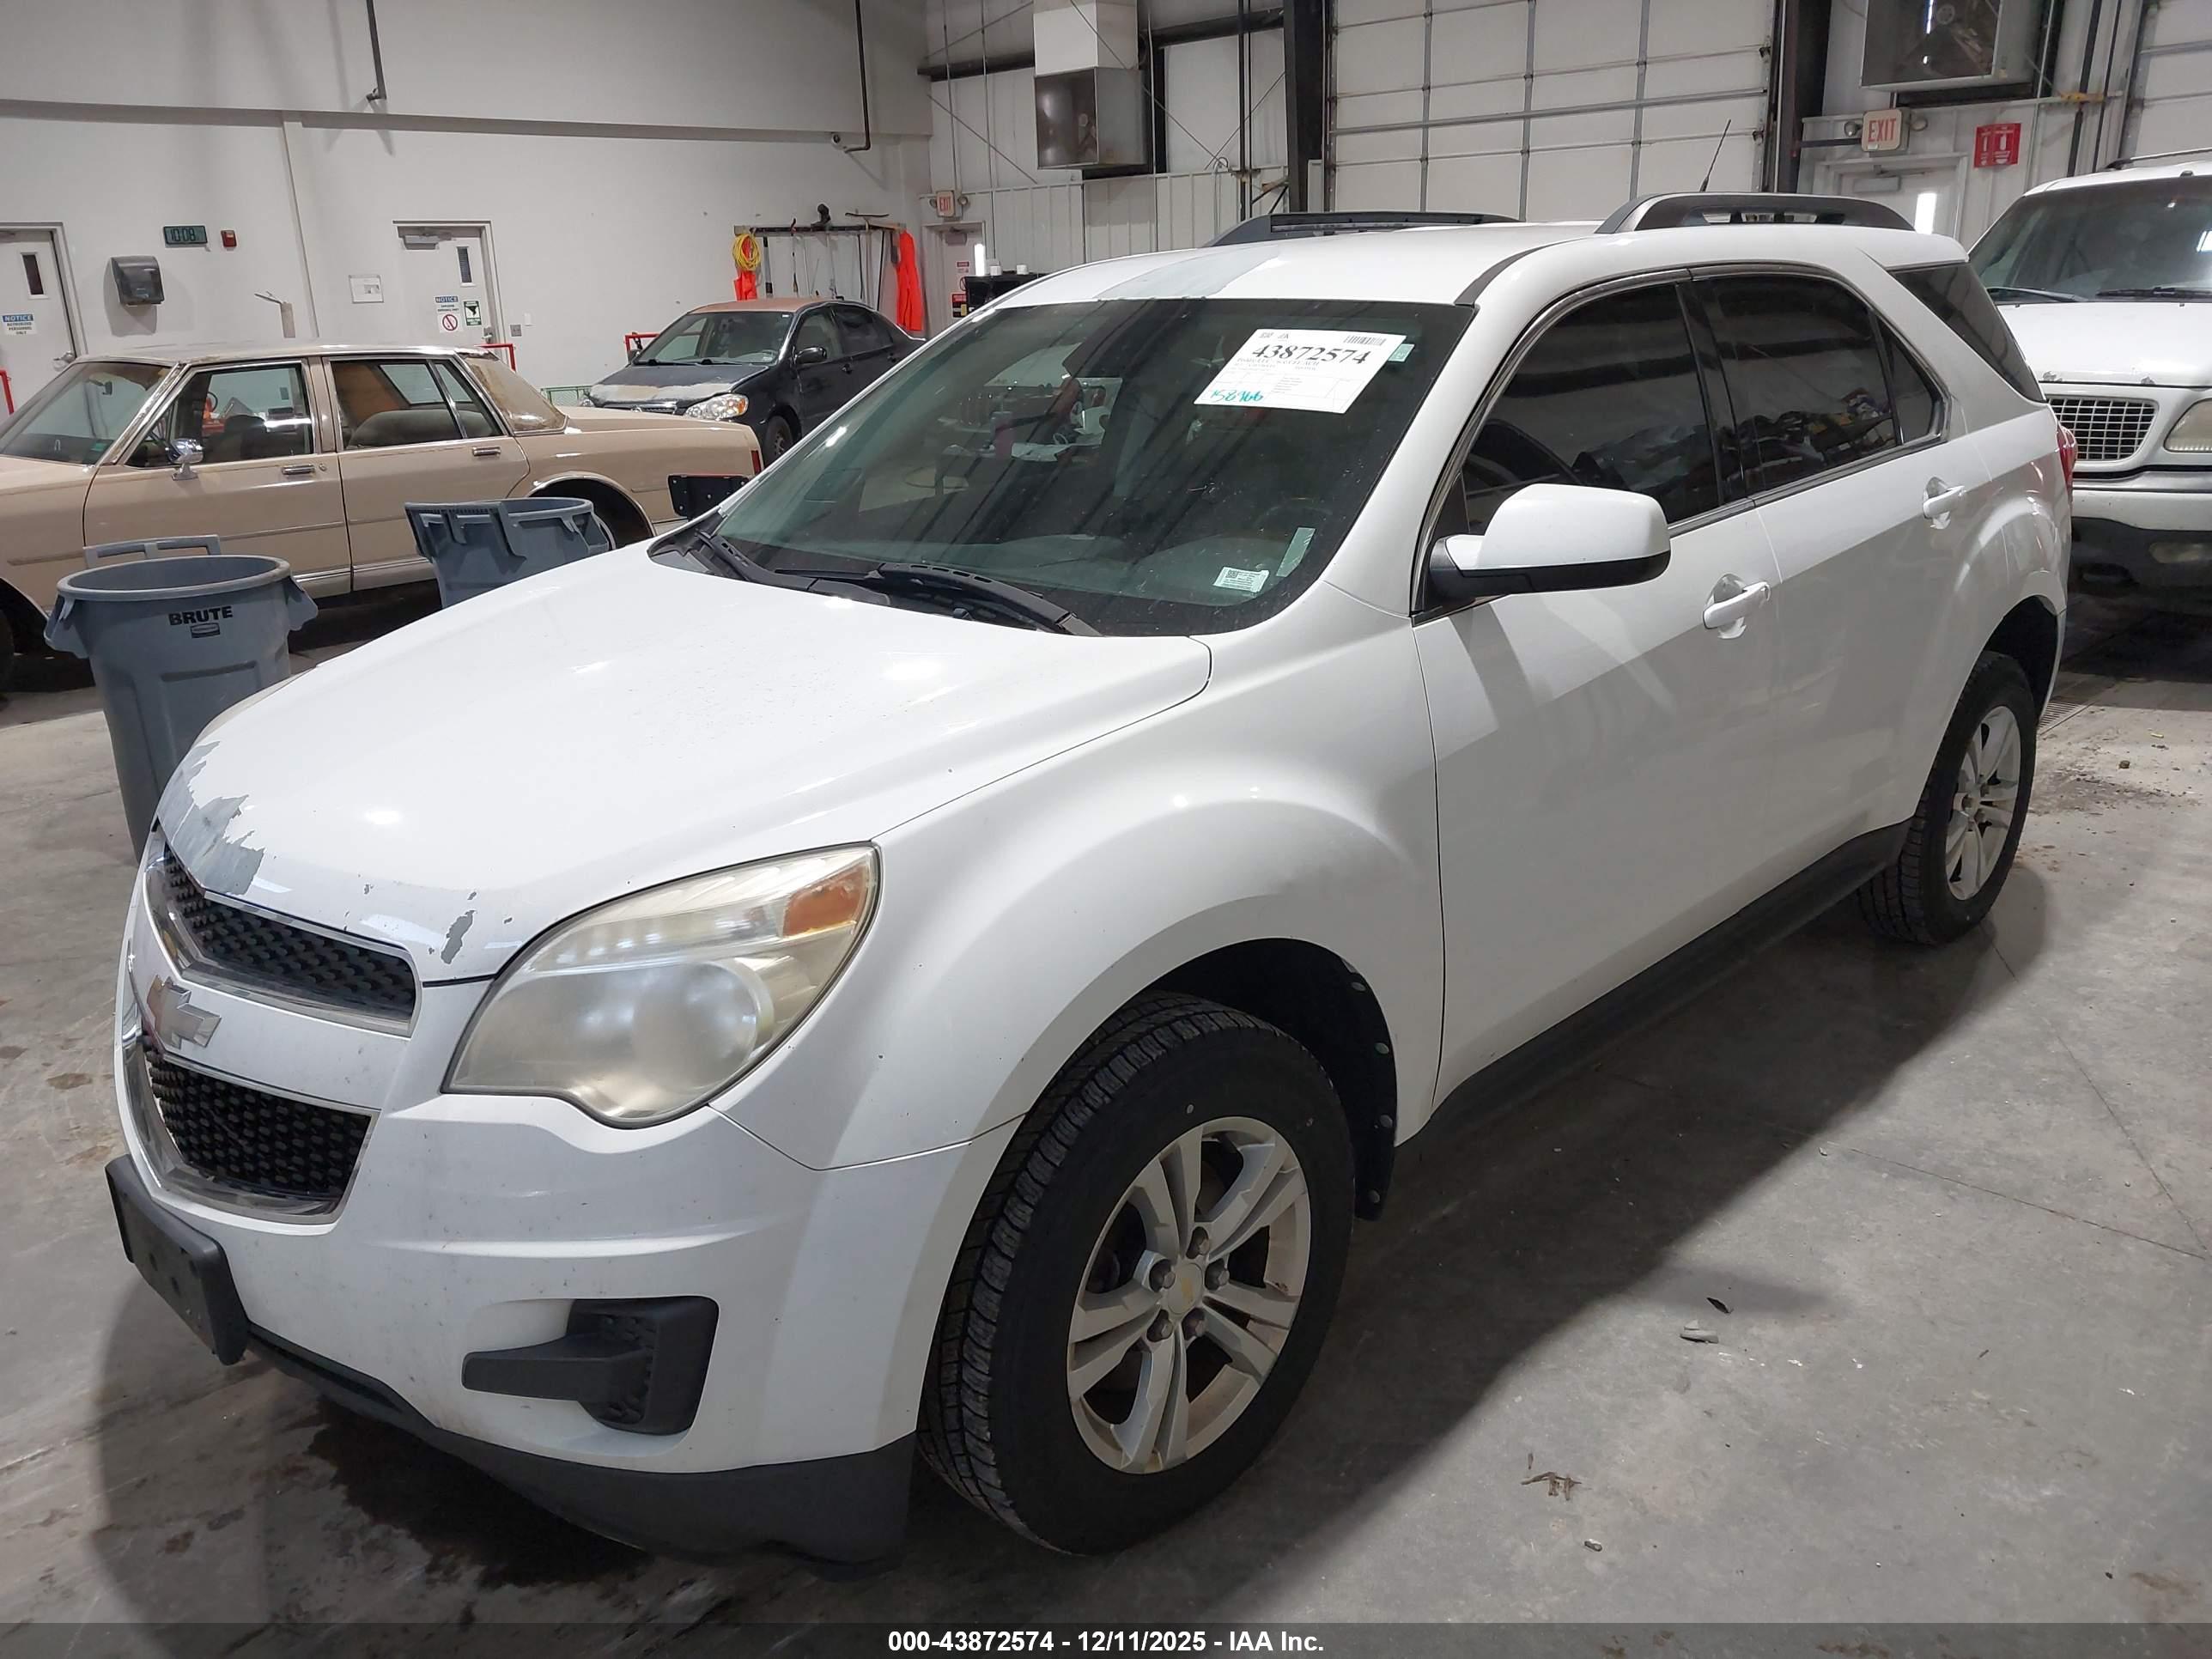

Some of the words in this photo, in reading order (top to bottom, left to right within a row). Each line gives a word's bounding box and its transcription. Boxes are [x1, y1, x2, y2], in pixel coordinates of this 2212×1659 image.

[1868, 118, 1896, 143] EXIT
[1252, 344, 1371, 364] 43872574
[168, 605, 233, 625] BRUTE
